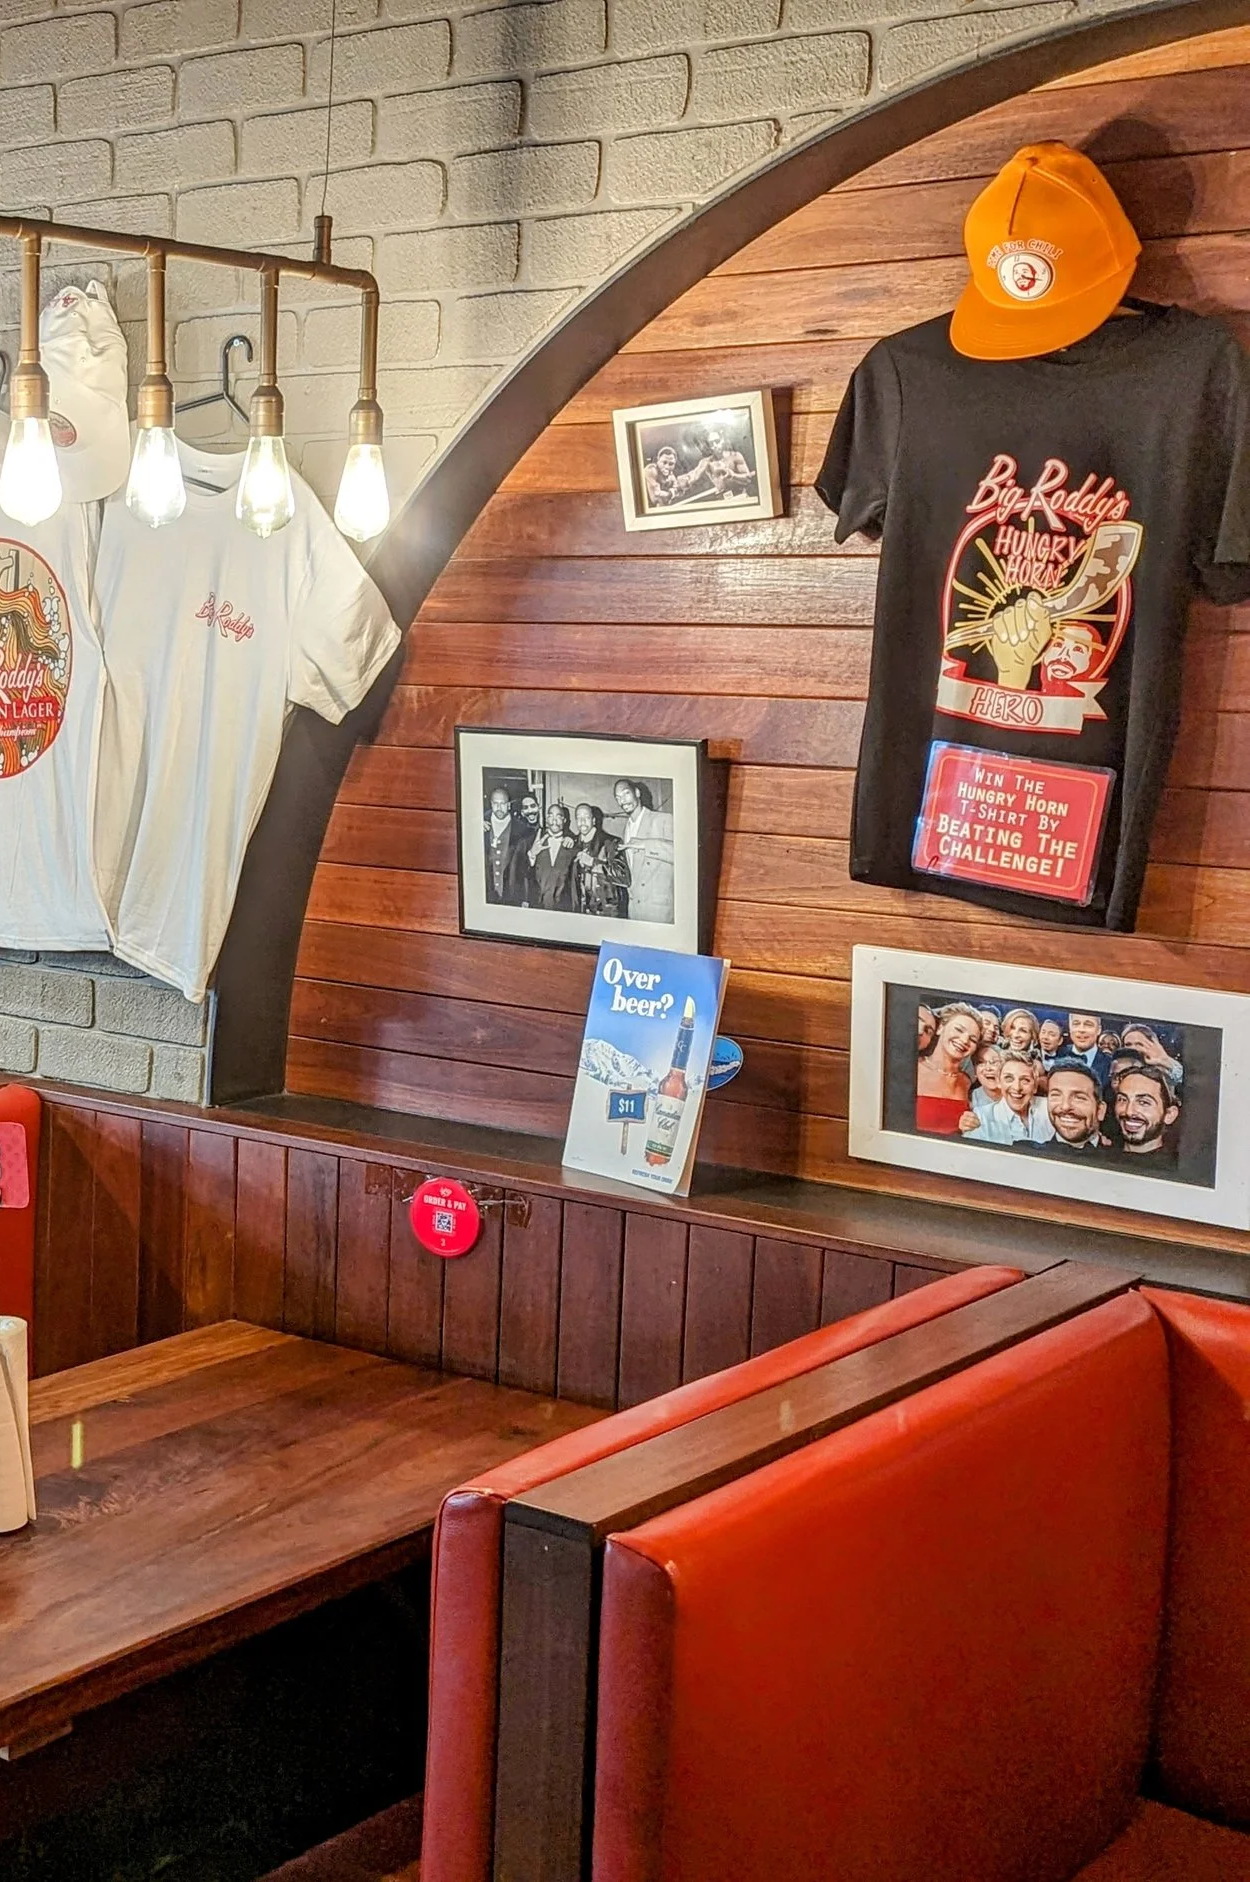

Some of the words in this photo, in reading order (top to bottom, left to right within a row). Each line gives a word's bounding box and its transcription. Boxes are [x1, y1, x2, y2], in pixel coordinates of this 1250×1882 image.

[965, 453, 1025, 525] Big
[1019, 458, 1131, 535] Roddy's
[994, 525, 1087, 565] HUNGRY
[1003, 555, 1065, 590] HORN
[12, 702, 55, 719] LAGER
[969, 687, 1044, 726] HERO
[974, 767, 1005, 787] WIN
[1015, 775, 1045, 795] THE
[957, 781, 1017, 807] HUNGRY
[1025, 795, 1069, 817] HORN
[960, 800, 1028, 827] T-SHIRT
[1038, 814, 1060, 833] BY
[936, 813, 1024, 849] BEATING
[1038, 833, 1079, 859] THE
[938, 835, 1065, 878] CHALLENGE!
[602, 957, 661, 992] Over
[610, 985, 676, 1020] beer?
[618, 1097, 635, 1114] $11
[423, 1194, 446, 1207] ORDER
[447, 1200, 453, 1208] &
[453, 1201, 467, 1212] PAY
